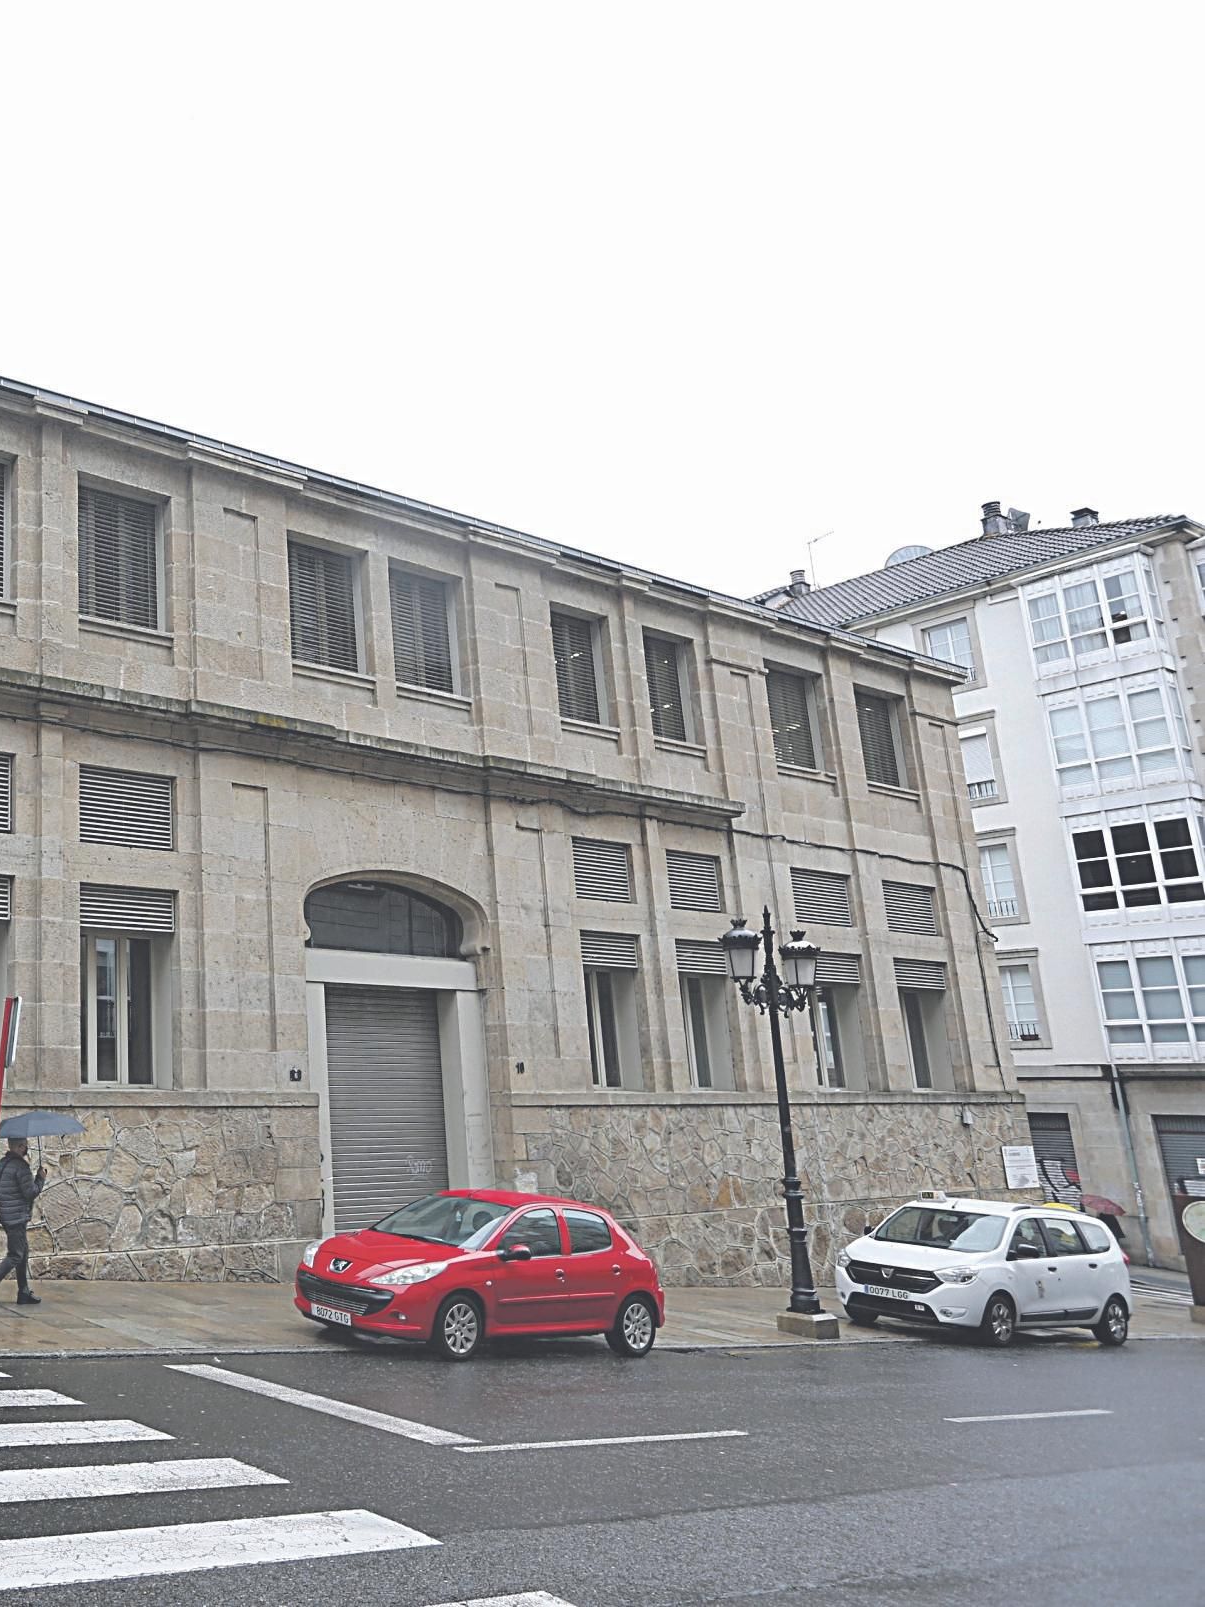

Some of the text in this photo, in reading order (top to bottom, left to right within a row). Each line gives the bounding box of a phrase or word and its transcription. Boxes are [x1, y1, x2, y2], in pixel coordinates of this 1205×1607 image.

[869, 1286, 909, 1300] 0077 LGG
[316, 1306, 349, 1324] 8072 GTG
